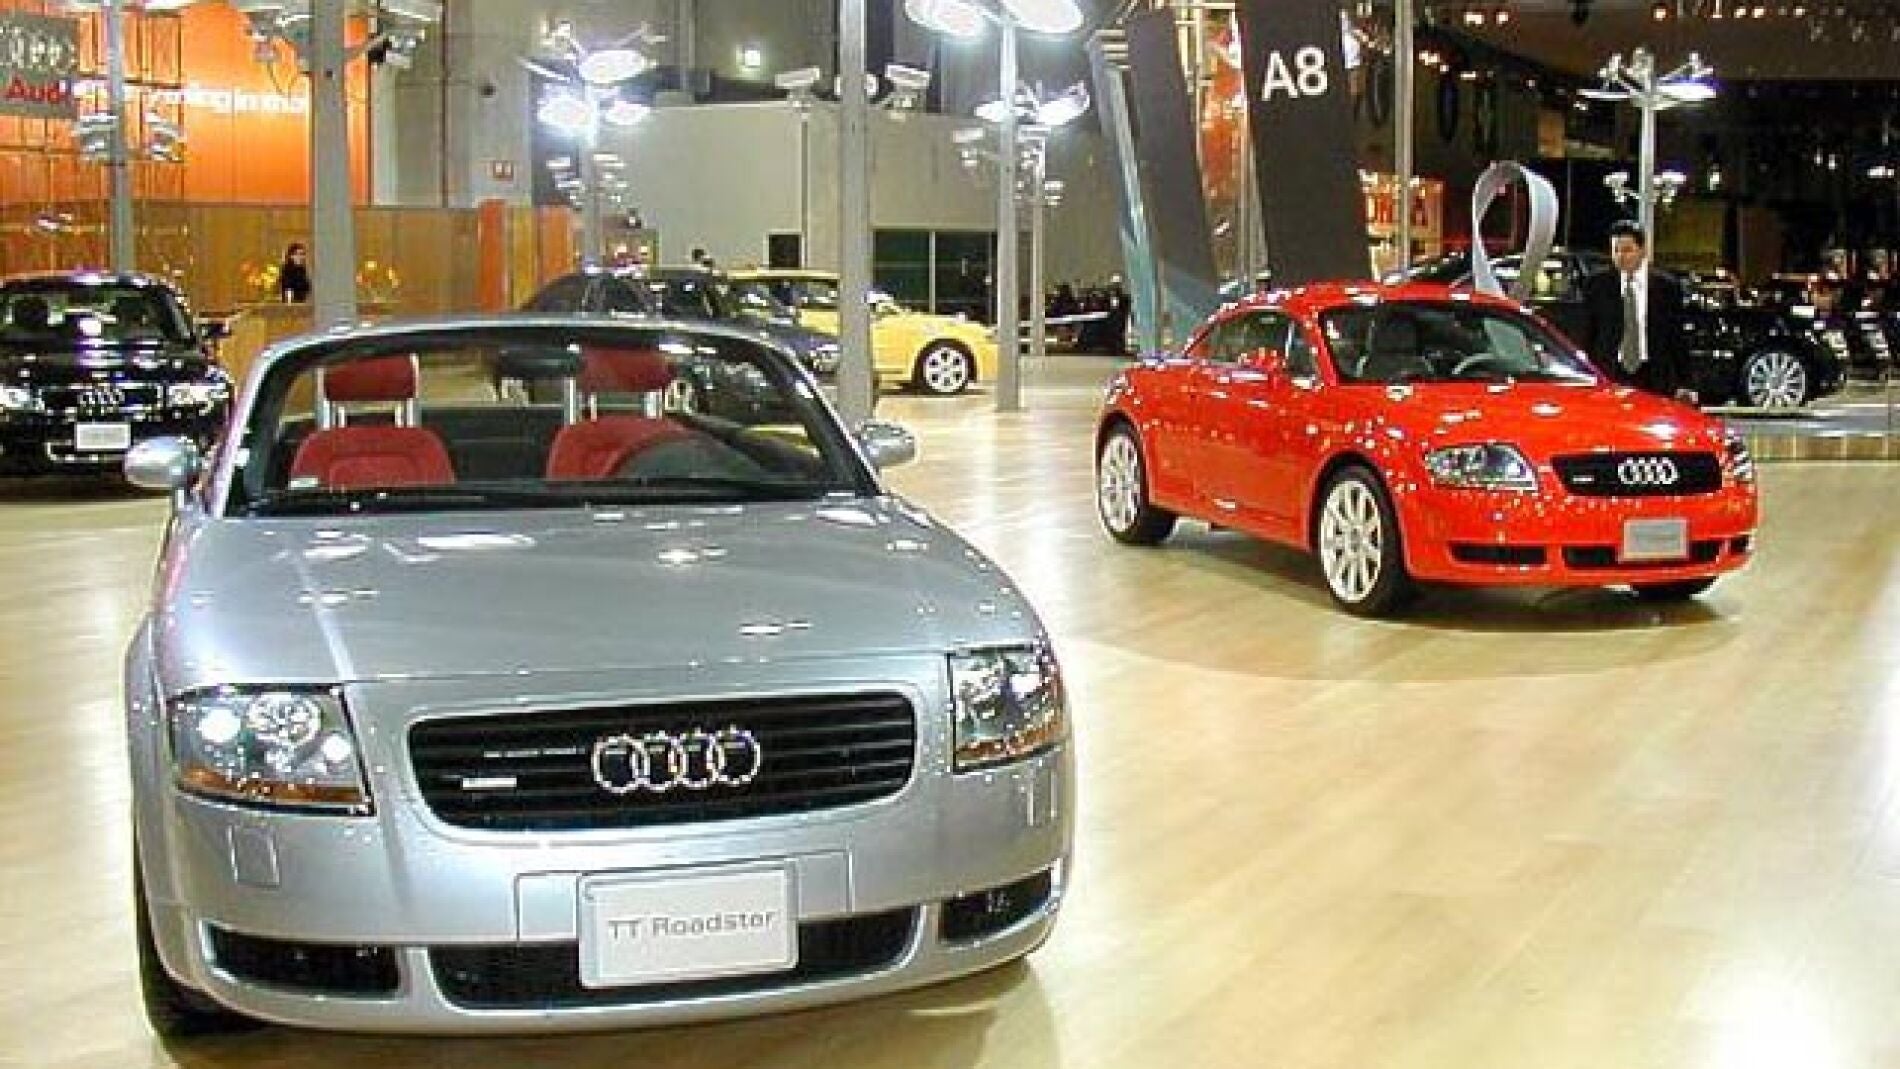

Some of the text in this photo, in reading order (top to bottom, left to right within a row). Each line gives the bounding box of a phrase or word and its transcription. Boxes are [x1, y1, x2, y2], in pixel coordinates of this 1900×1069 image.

[1261, 46, 1328, 101] A8
[607, 910, 776, 940] TT Roadster
